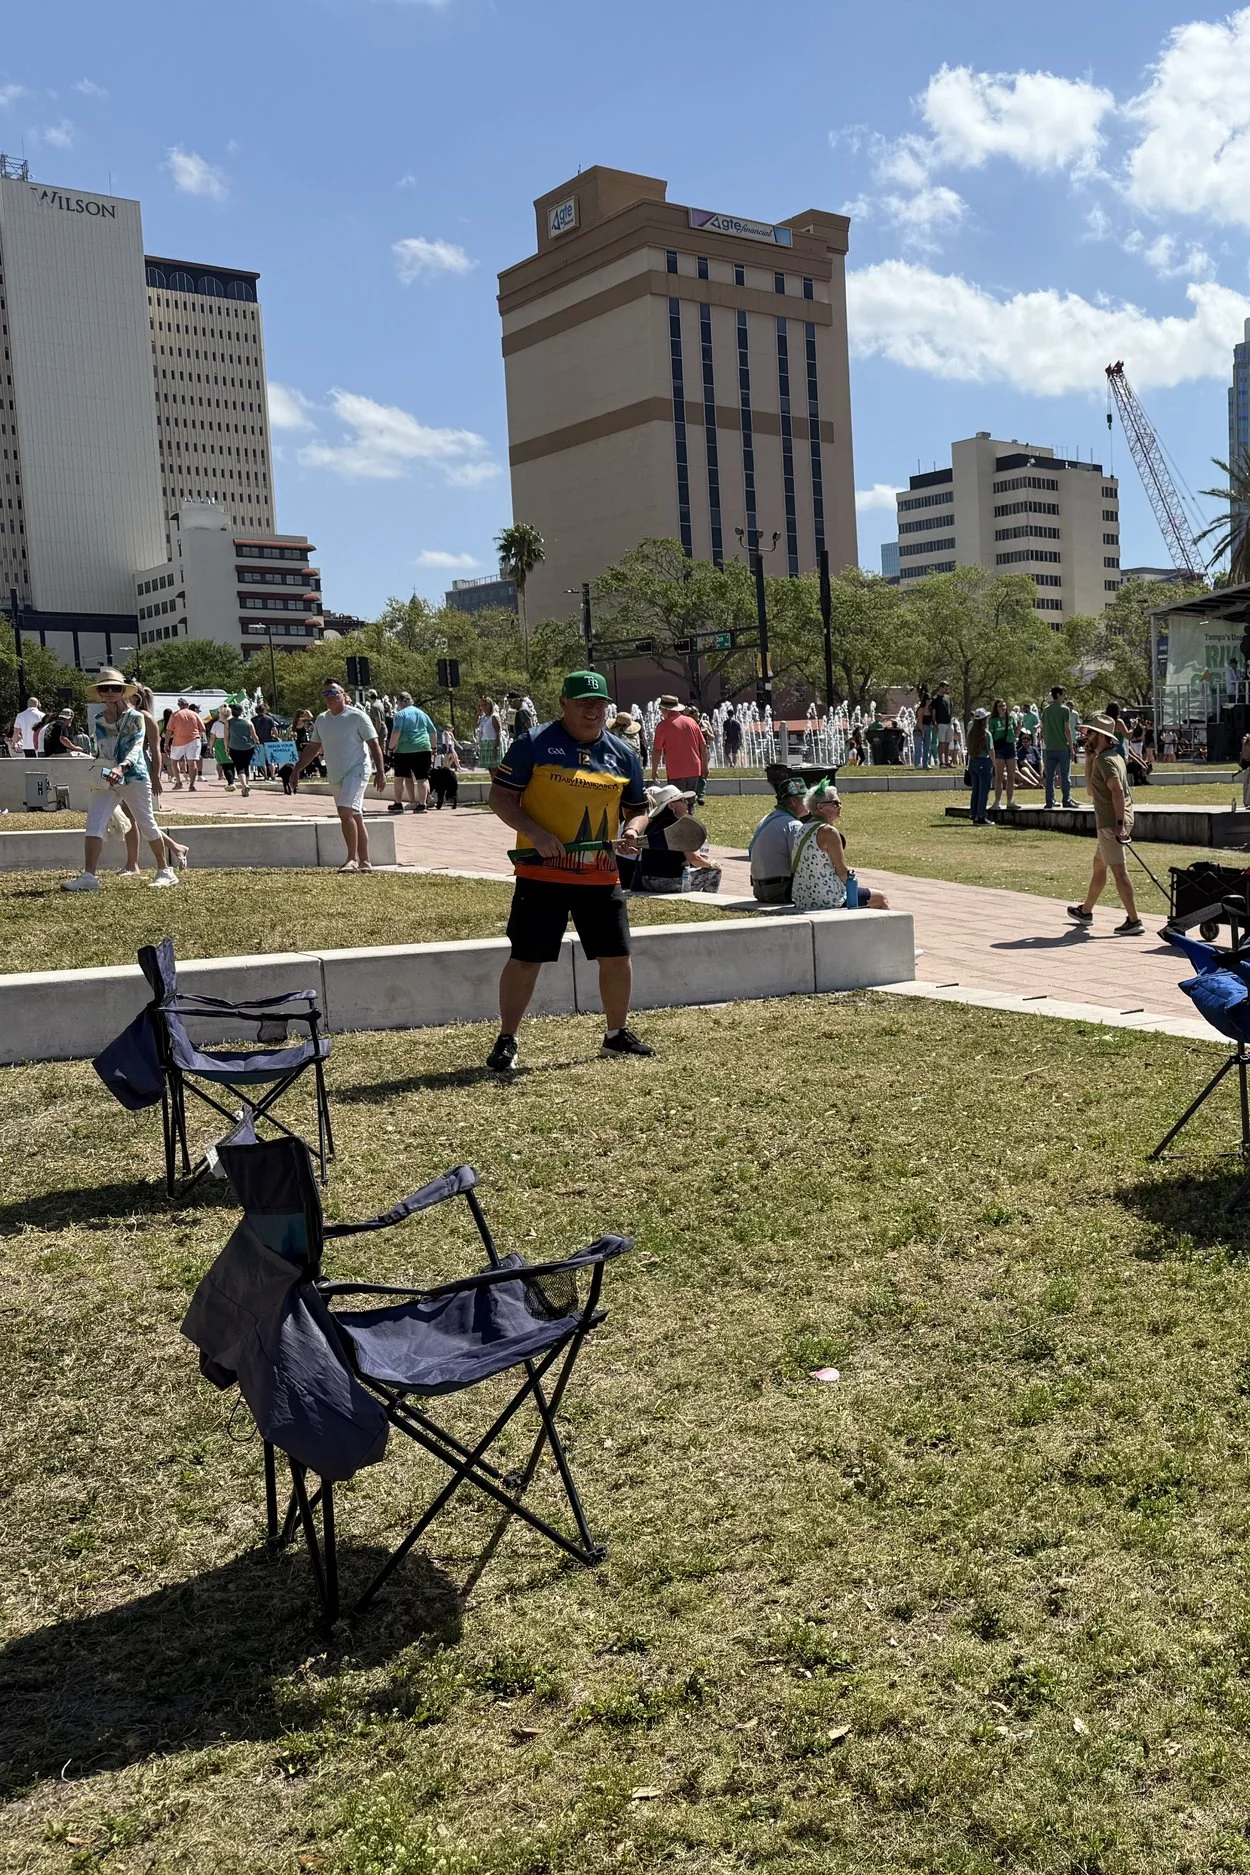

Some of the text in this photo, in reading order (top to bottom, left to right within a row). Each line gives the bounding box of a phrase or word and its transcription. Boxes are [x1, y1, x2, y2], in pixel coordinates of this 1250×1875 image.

[30, 187, 116, 219] WILSON
[737, 223, 773, 238] financial
[578, 752, 592, 766] 12
